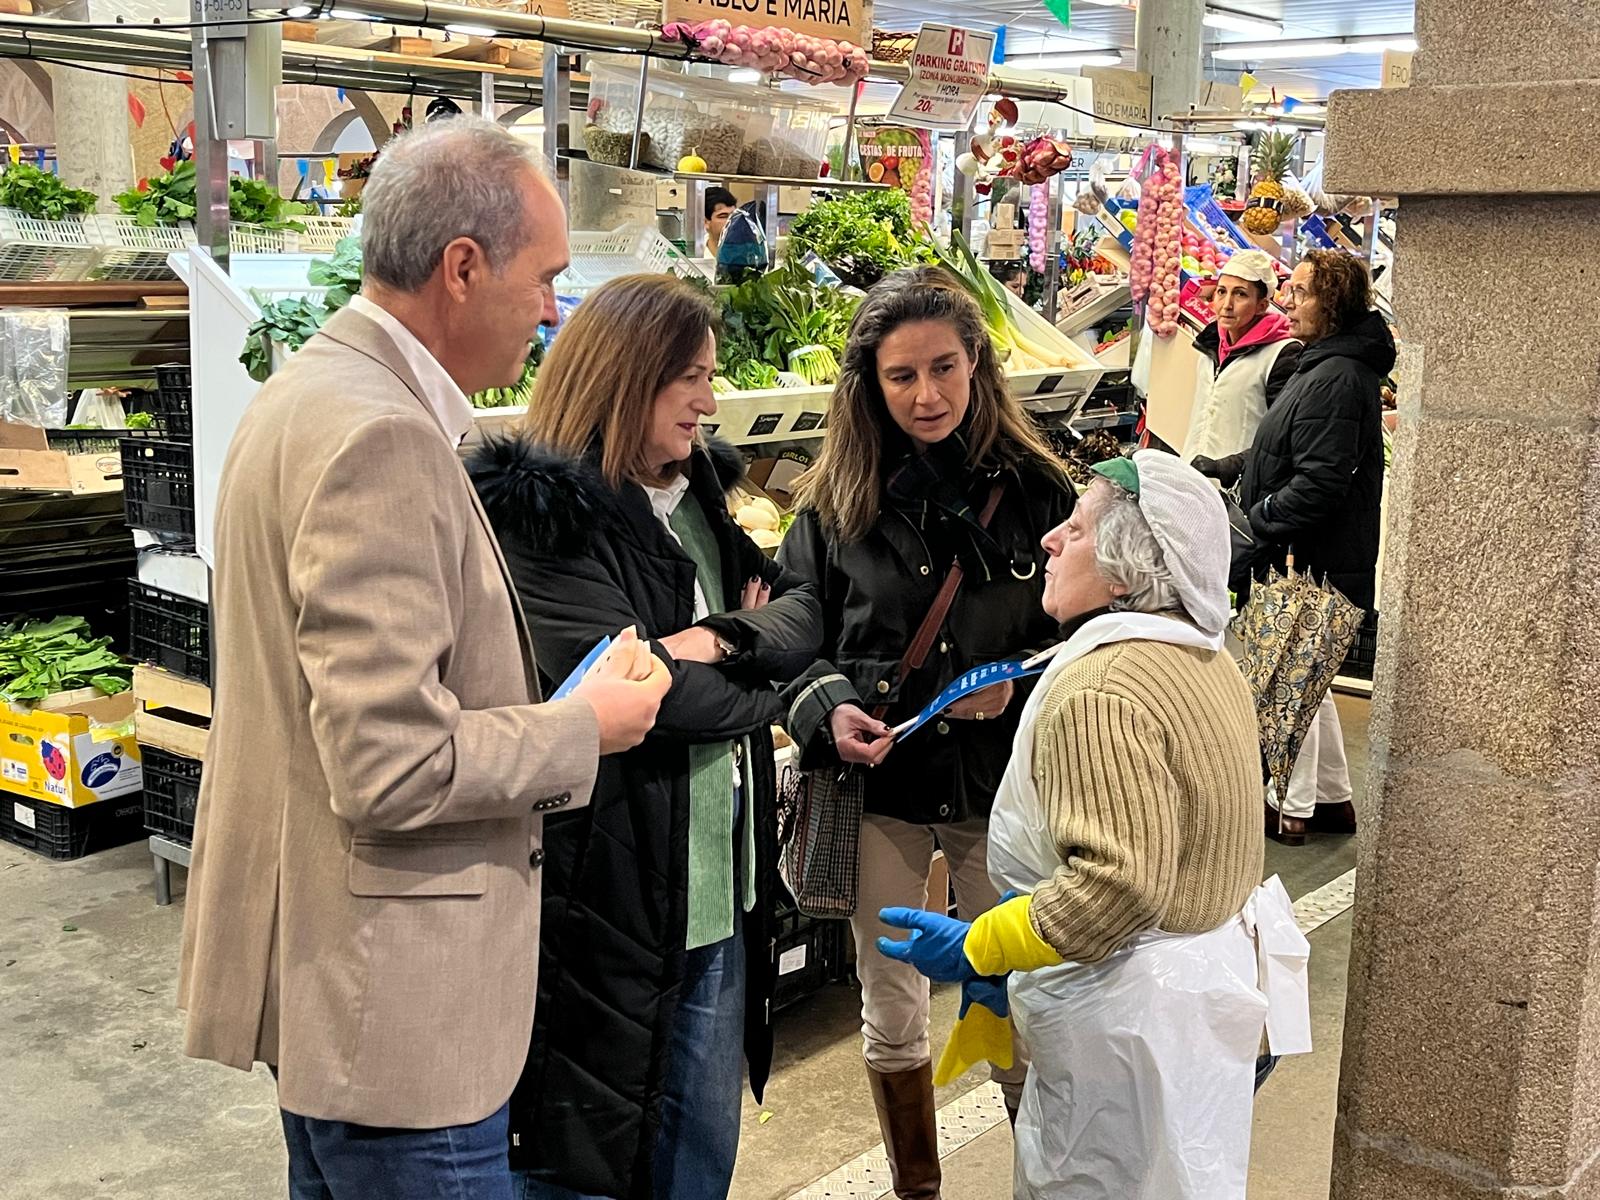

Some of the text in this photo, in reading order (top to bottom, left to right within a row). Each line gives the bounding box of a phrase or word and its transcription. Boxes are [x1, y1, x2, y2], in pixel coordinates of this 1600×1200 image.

[915, 54, 986, 76] PARKING GRATUITO
[941, 85, 960, 97] HORA
[1121, 104, 1147, 121] MARÍA
[860, 145, 925, 158] CESTAS DE FRUTA
[44, 781, 67, 796] Natur
